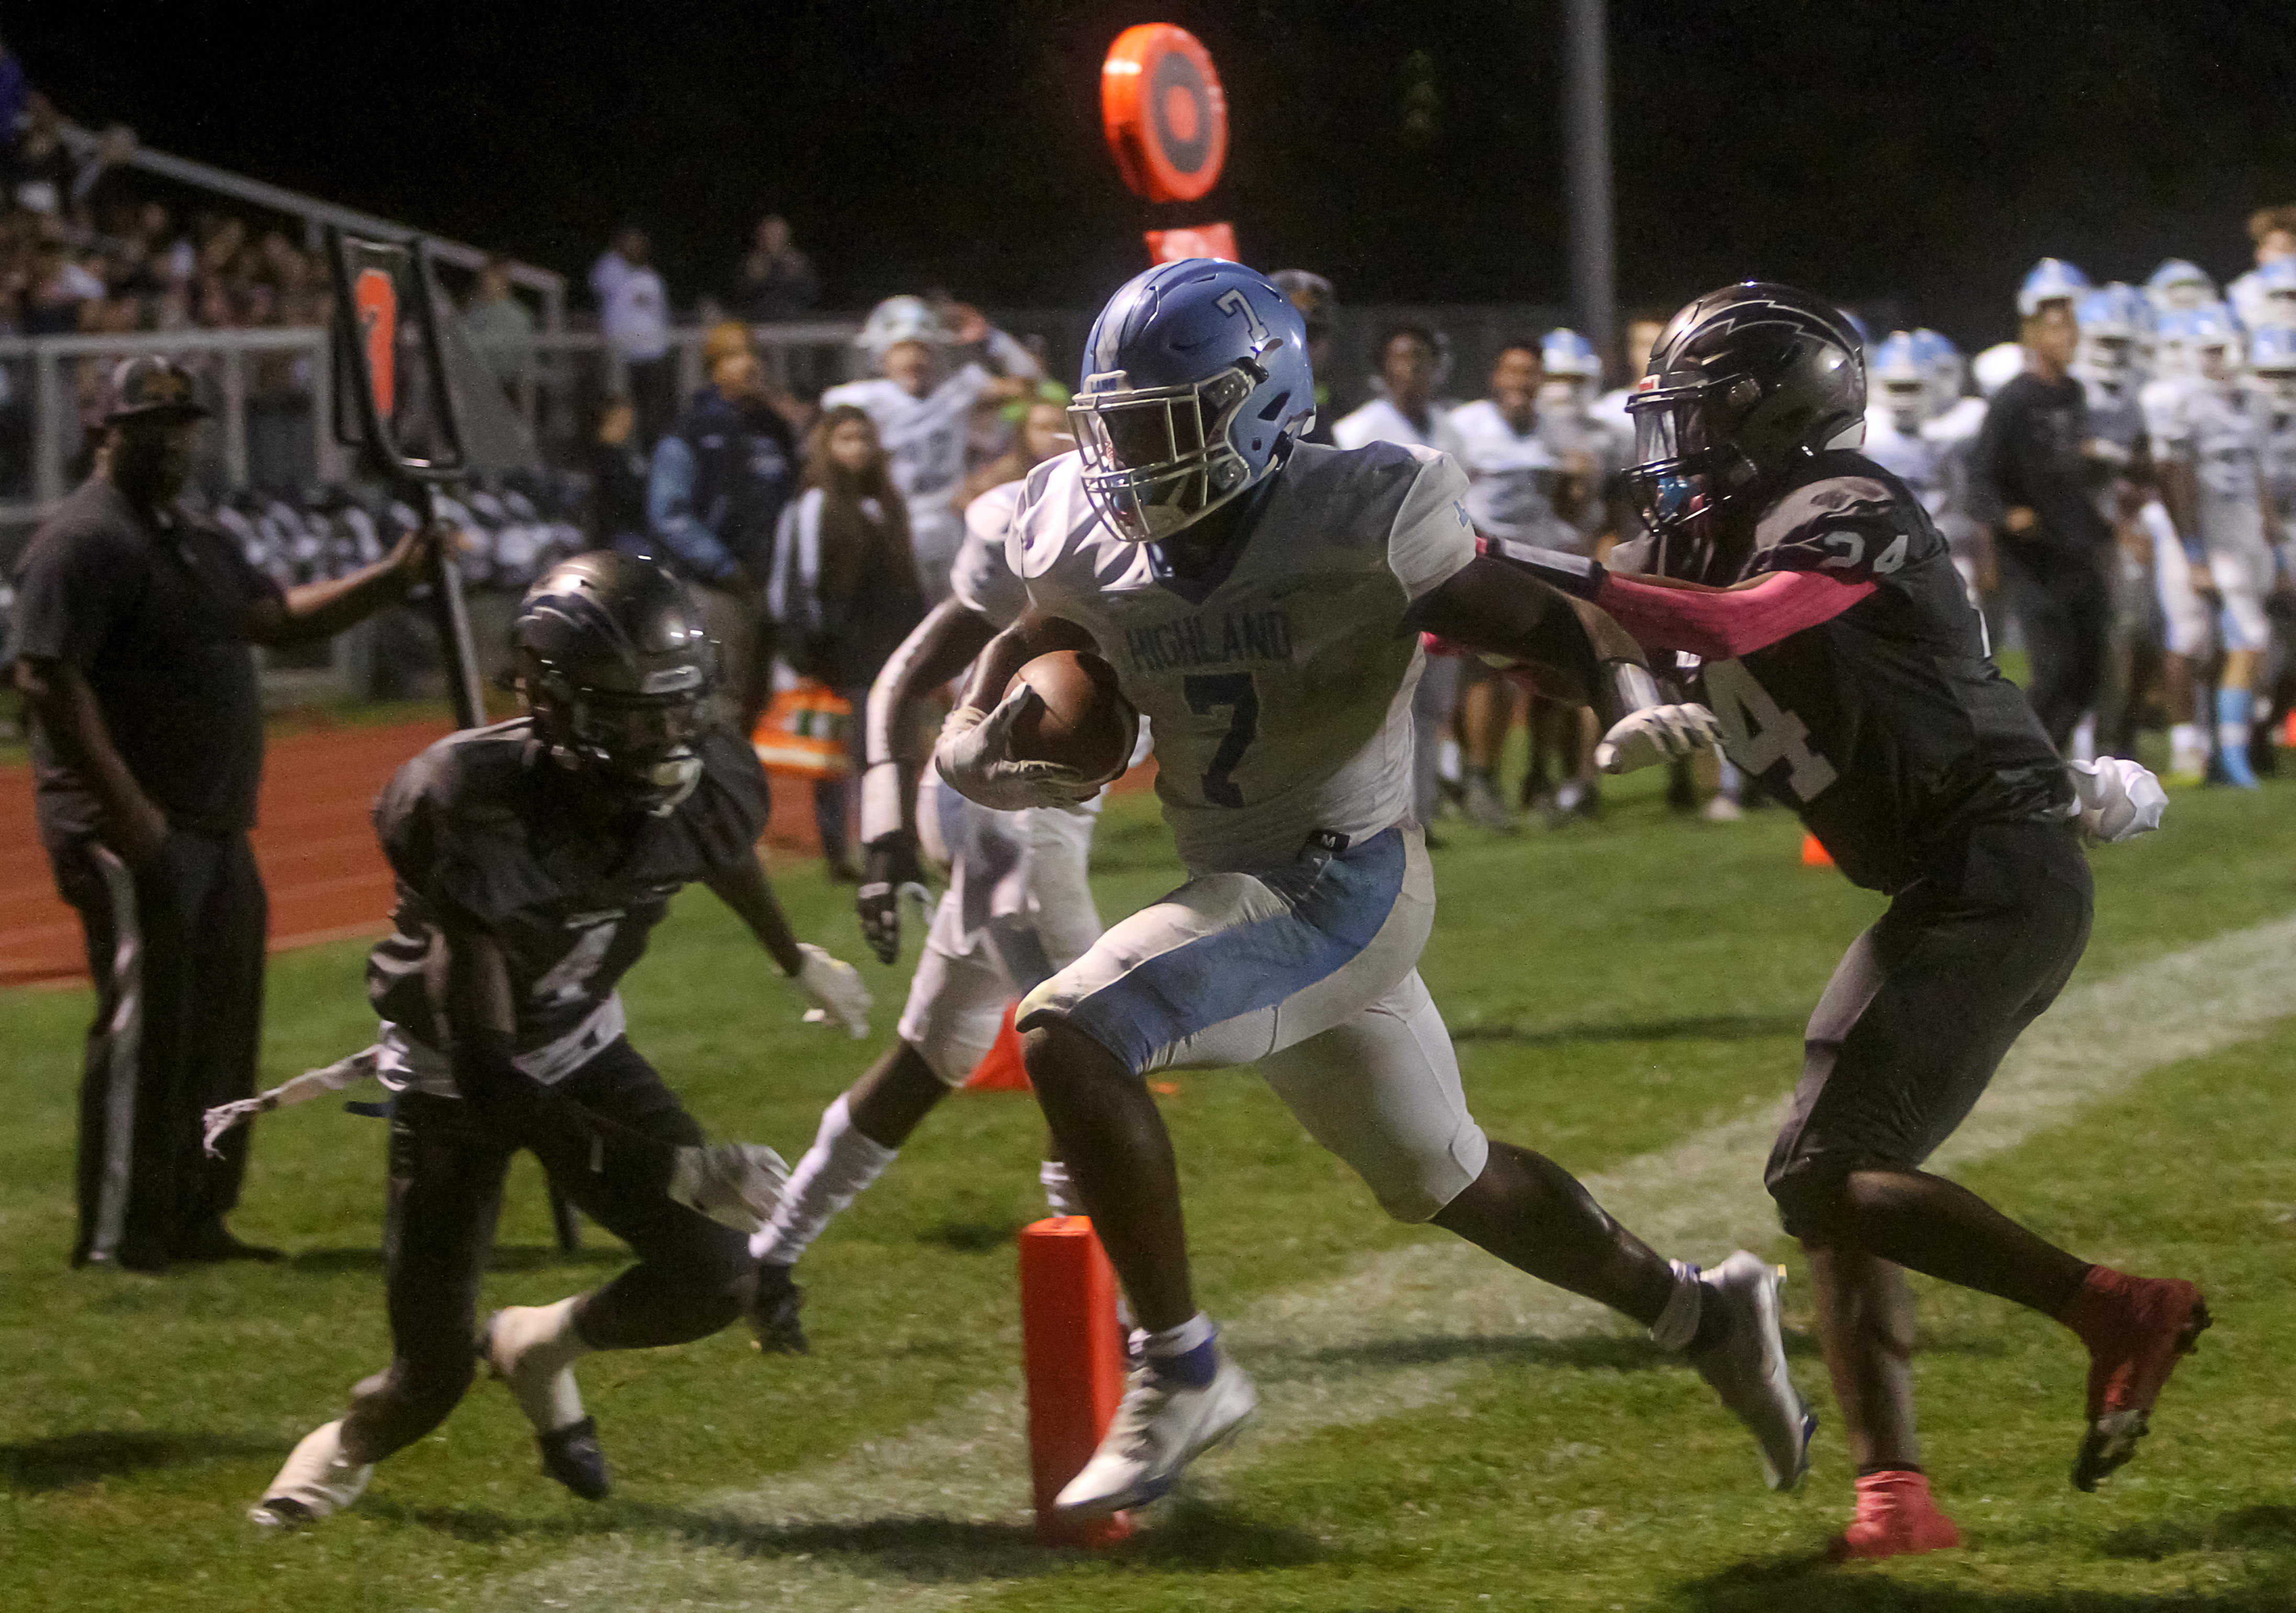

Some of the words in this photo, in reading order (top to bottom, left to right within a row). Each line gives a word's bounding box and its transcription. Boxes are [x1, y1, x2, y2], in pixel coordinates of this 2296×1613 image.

[1212, 286, 1270, 343] 7
[1125, 611, 1293, 671] HIGHLAND
[1184, 672, 1259, 809] 7
